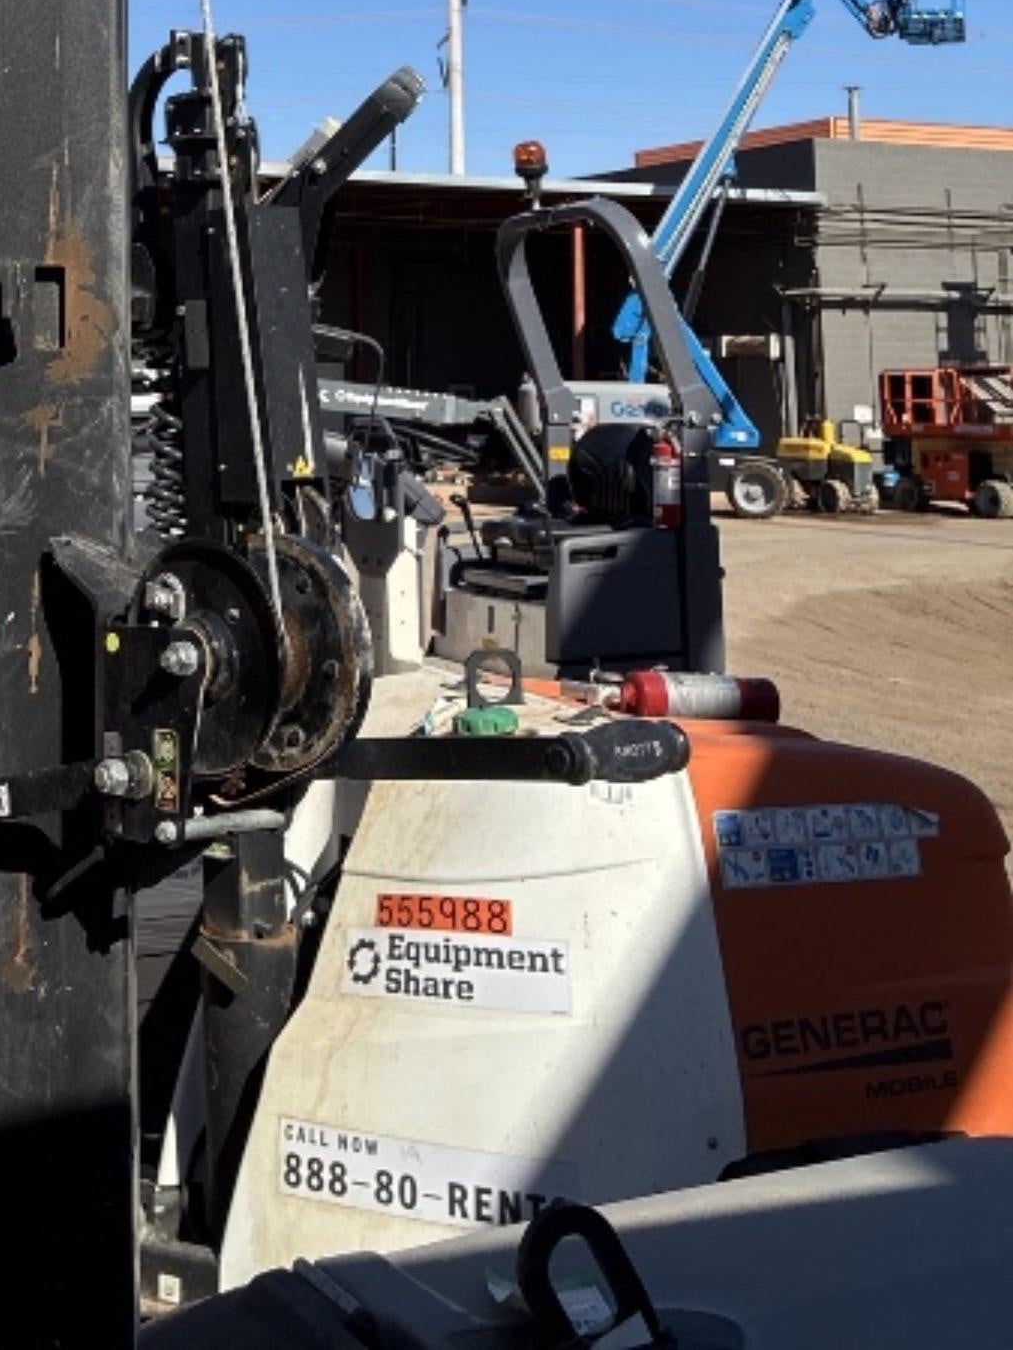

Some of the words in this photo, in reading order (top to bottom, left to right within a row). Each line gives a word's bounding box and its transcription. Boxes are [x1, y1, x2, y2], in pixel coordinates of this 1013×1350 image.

[377, 896, 508, 934] 555988
[387, 933, 565, 974] Equipment
[385, 968, 475, 1001] Share
[742, 1002, 950, 1060] GENERAC
[865, 1070, 957, 1099] MOBILE
[284, 1124, 329, 1147] CALL
[337, 1133, 379, 1156] NOW
